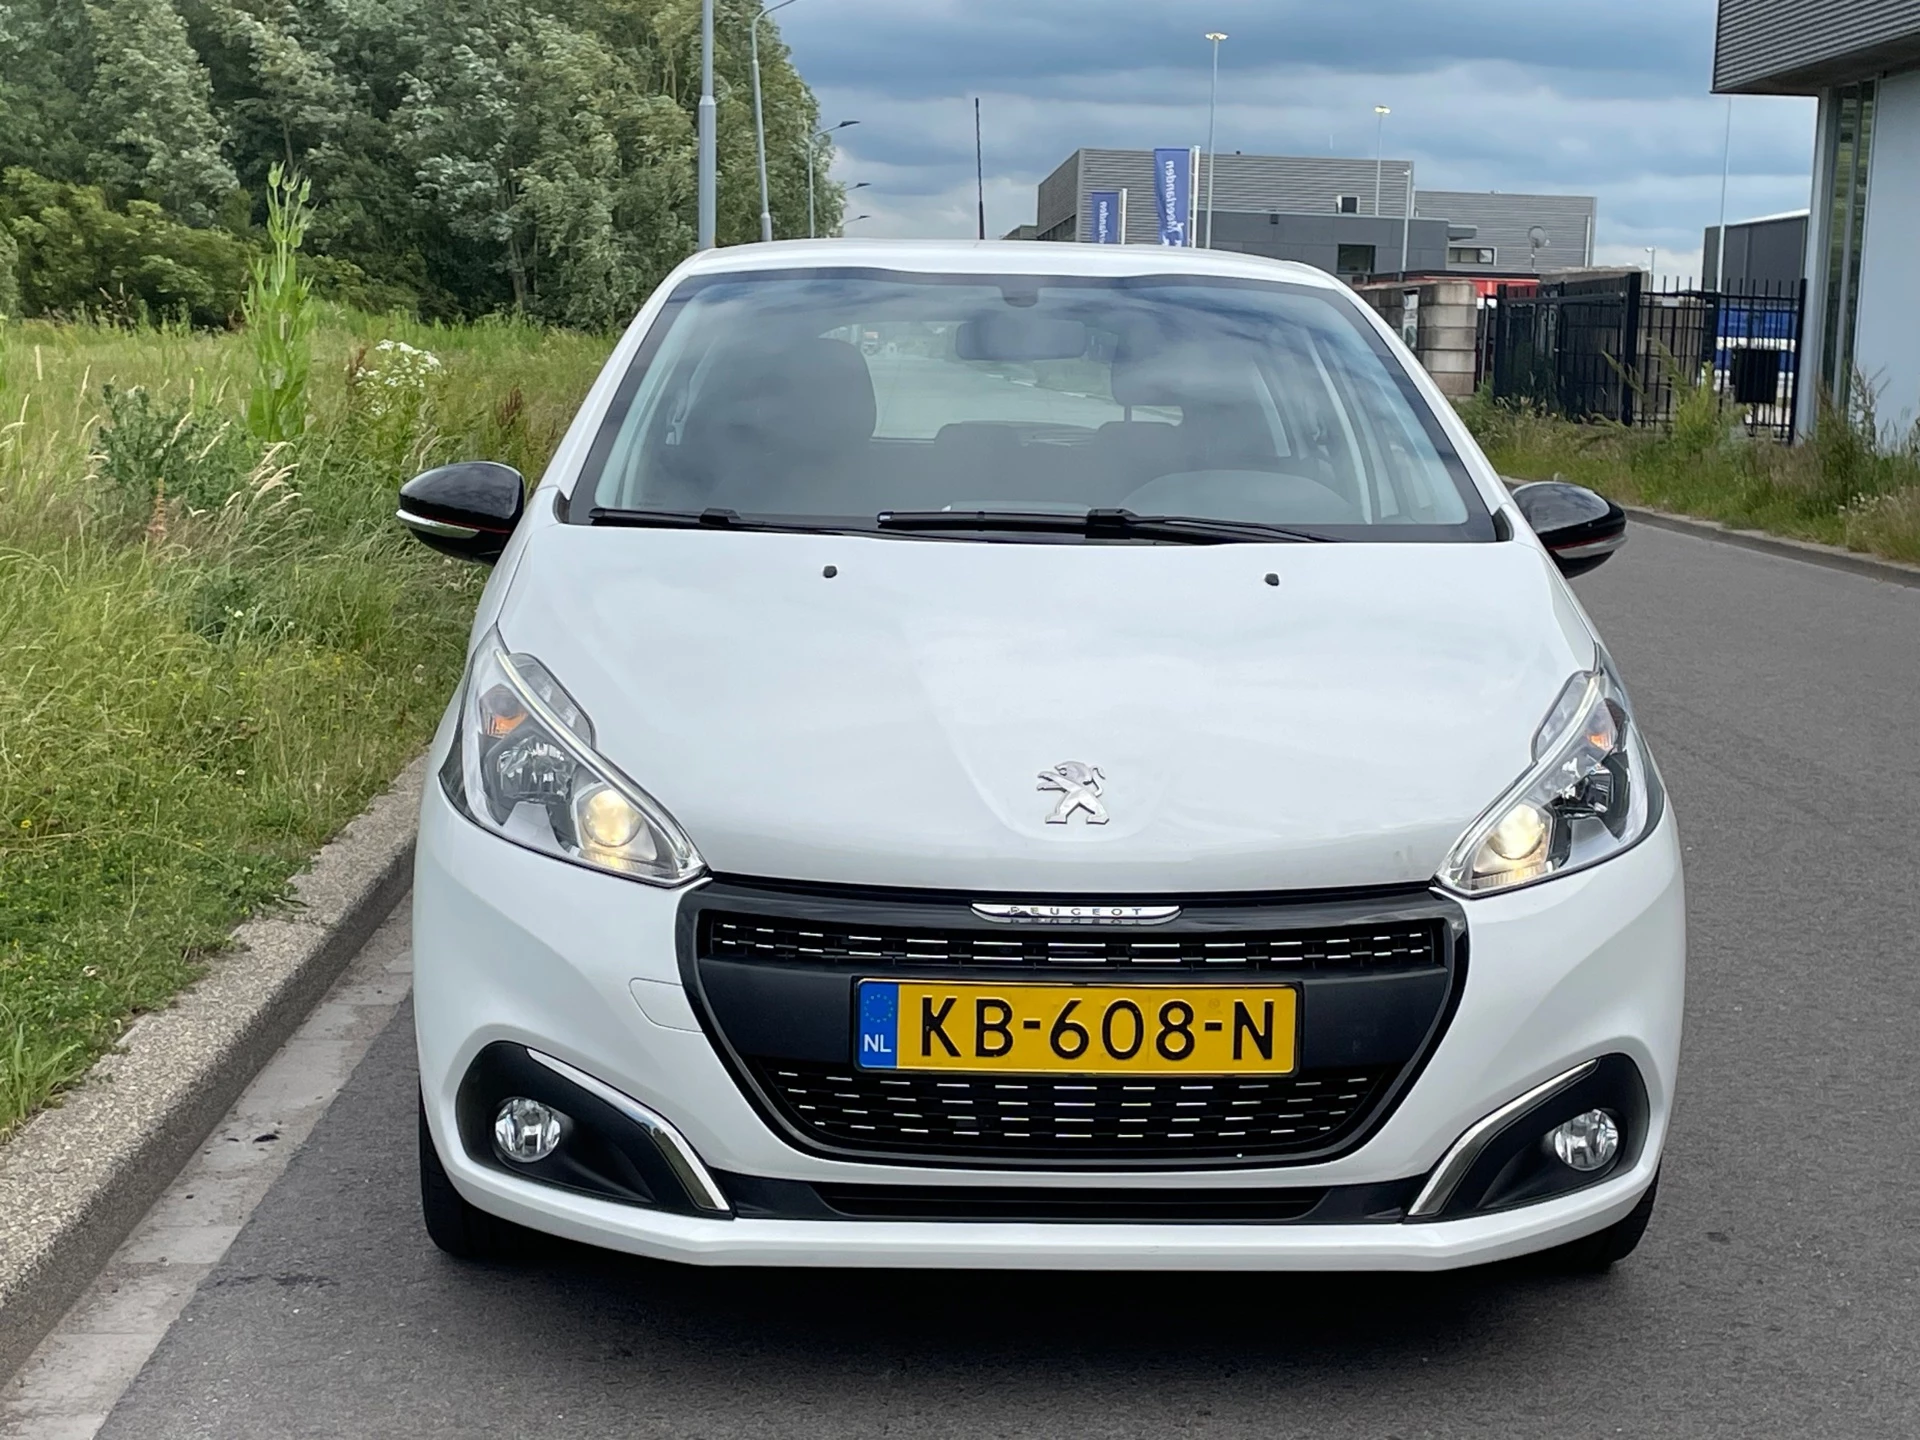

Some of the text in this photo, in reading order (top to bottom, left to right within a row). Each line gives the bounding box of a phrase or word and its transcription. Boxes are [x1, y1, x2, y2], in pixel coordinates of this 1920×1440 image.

[1008, 906, 1143, 916] PEUGEOT
[863, 995, 1275, 1060] NL KB-608-N
